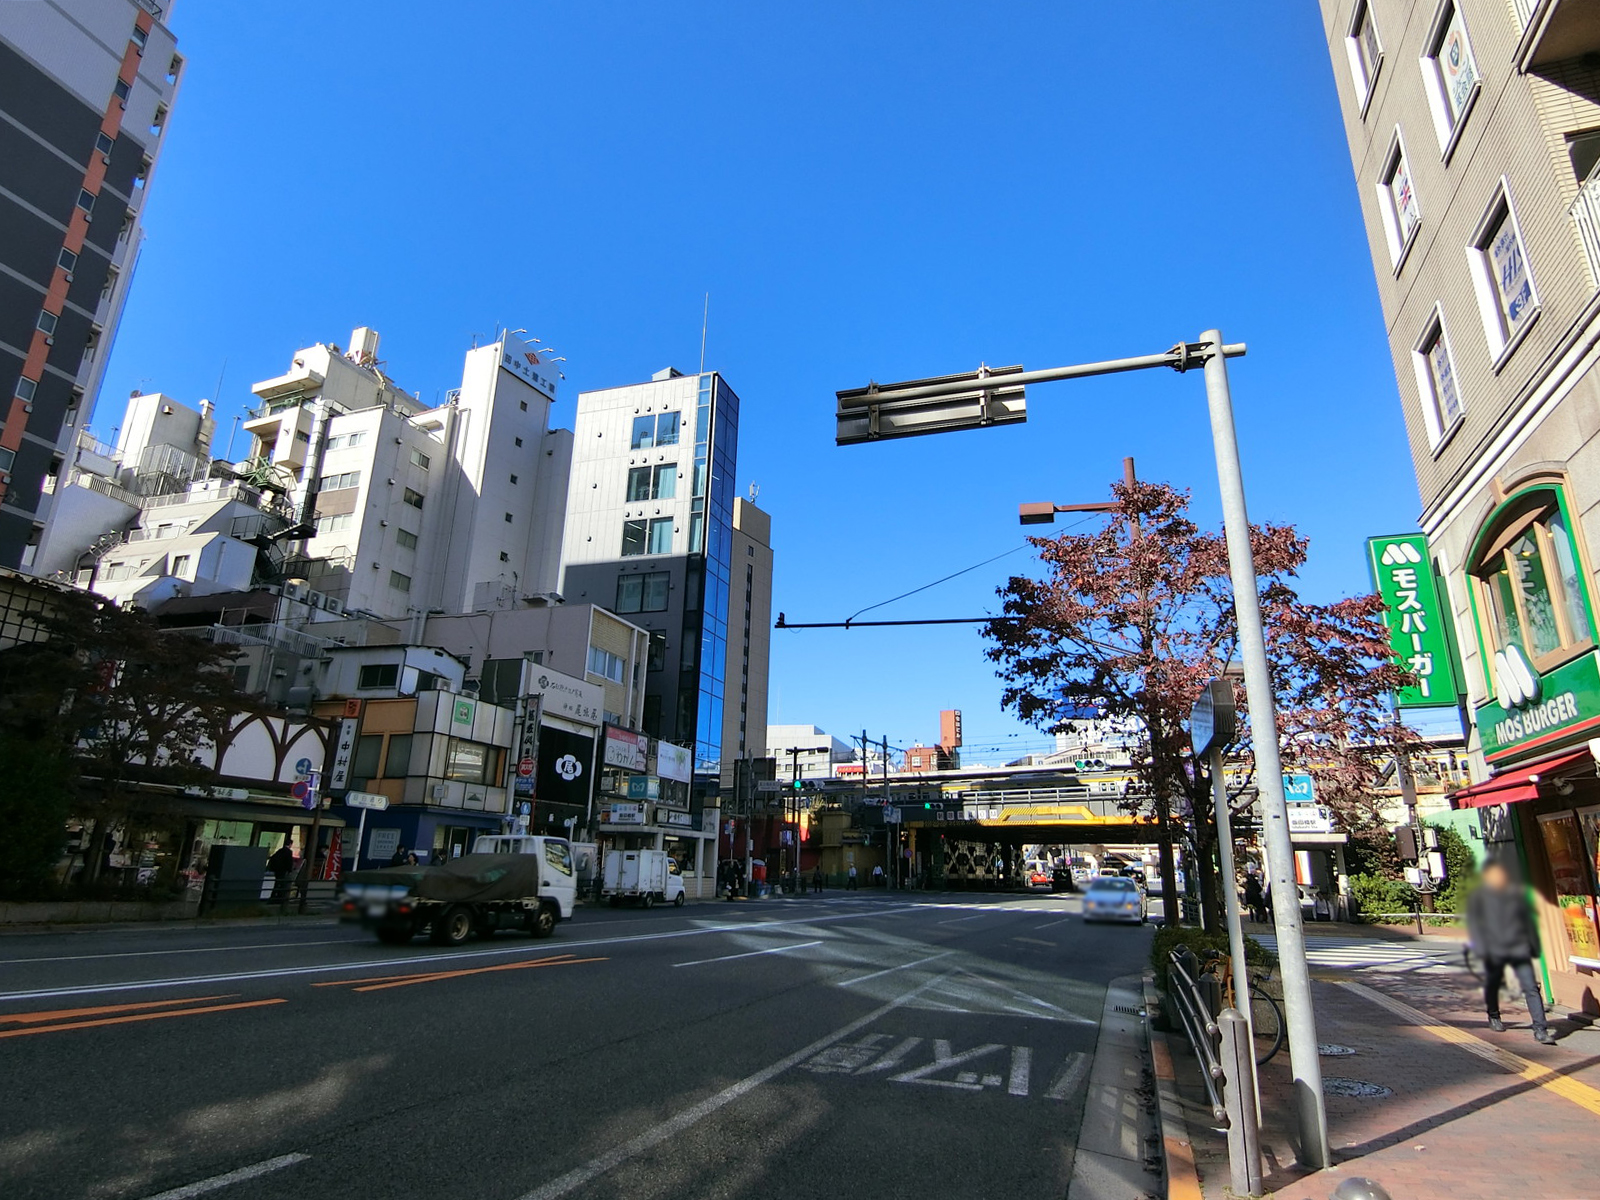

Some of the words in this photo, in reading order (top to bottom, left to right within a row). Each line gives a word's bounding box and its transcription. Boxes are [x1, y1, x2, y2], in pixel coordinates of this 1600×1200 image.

[1391, 568, 1433, 698] モスバーガー
[1495, 713, 1524, 746] MOS
[1523, 692, 1578, 737] BURGER
[334, 741, 350, 782] 中村屋
